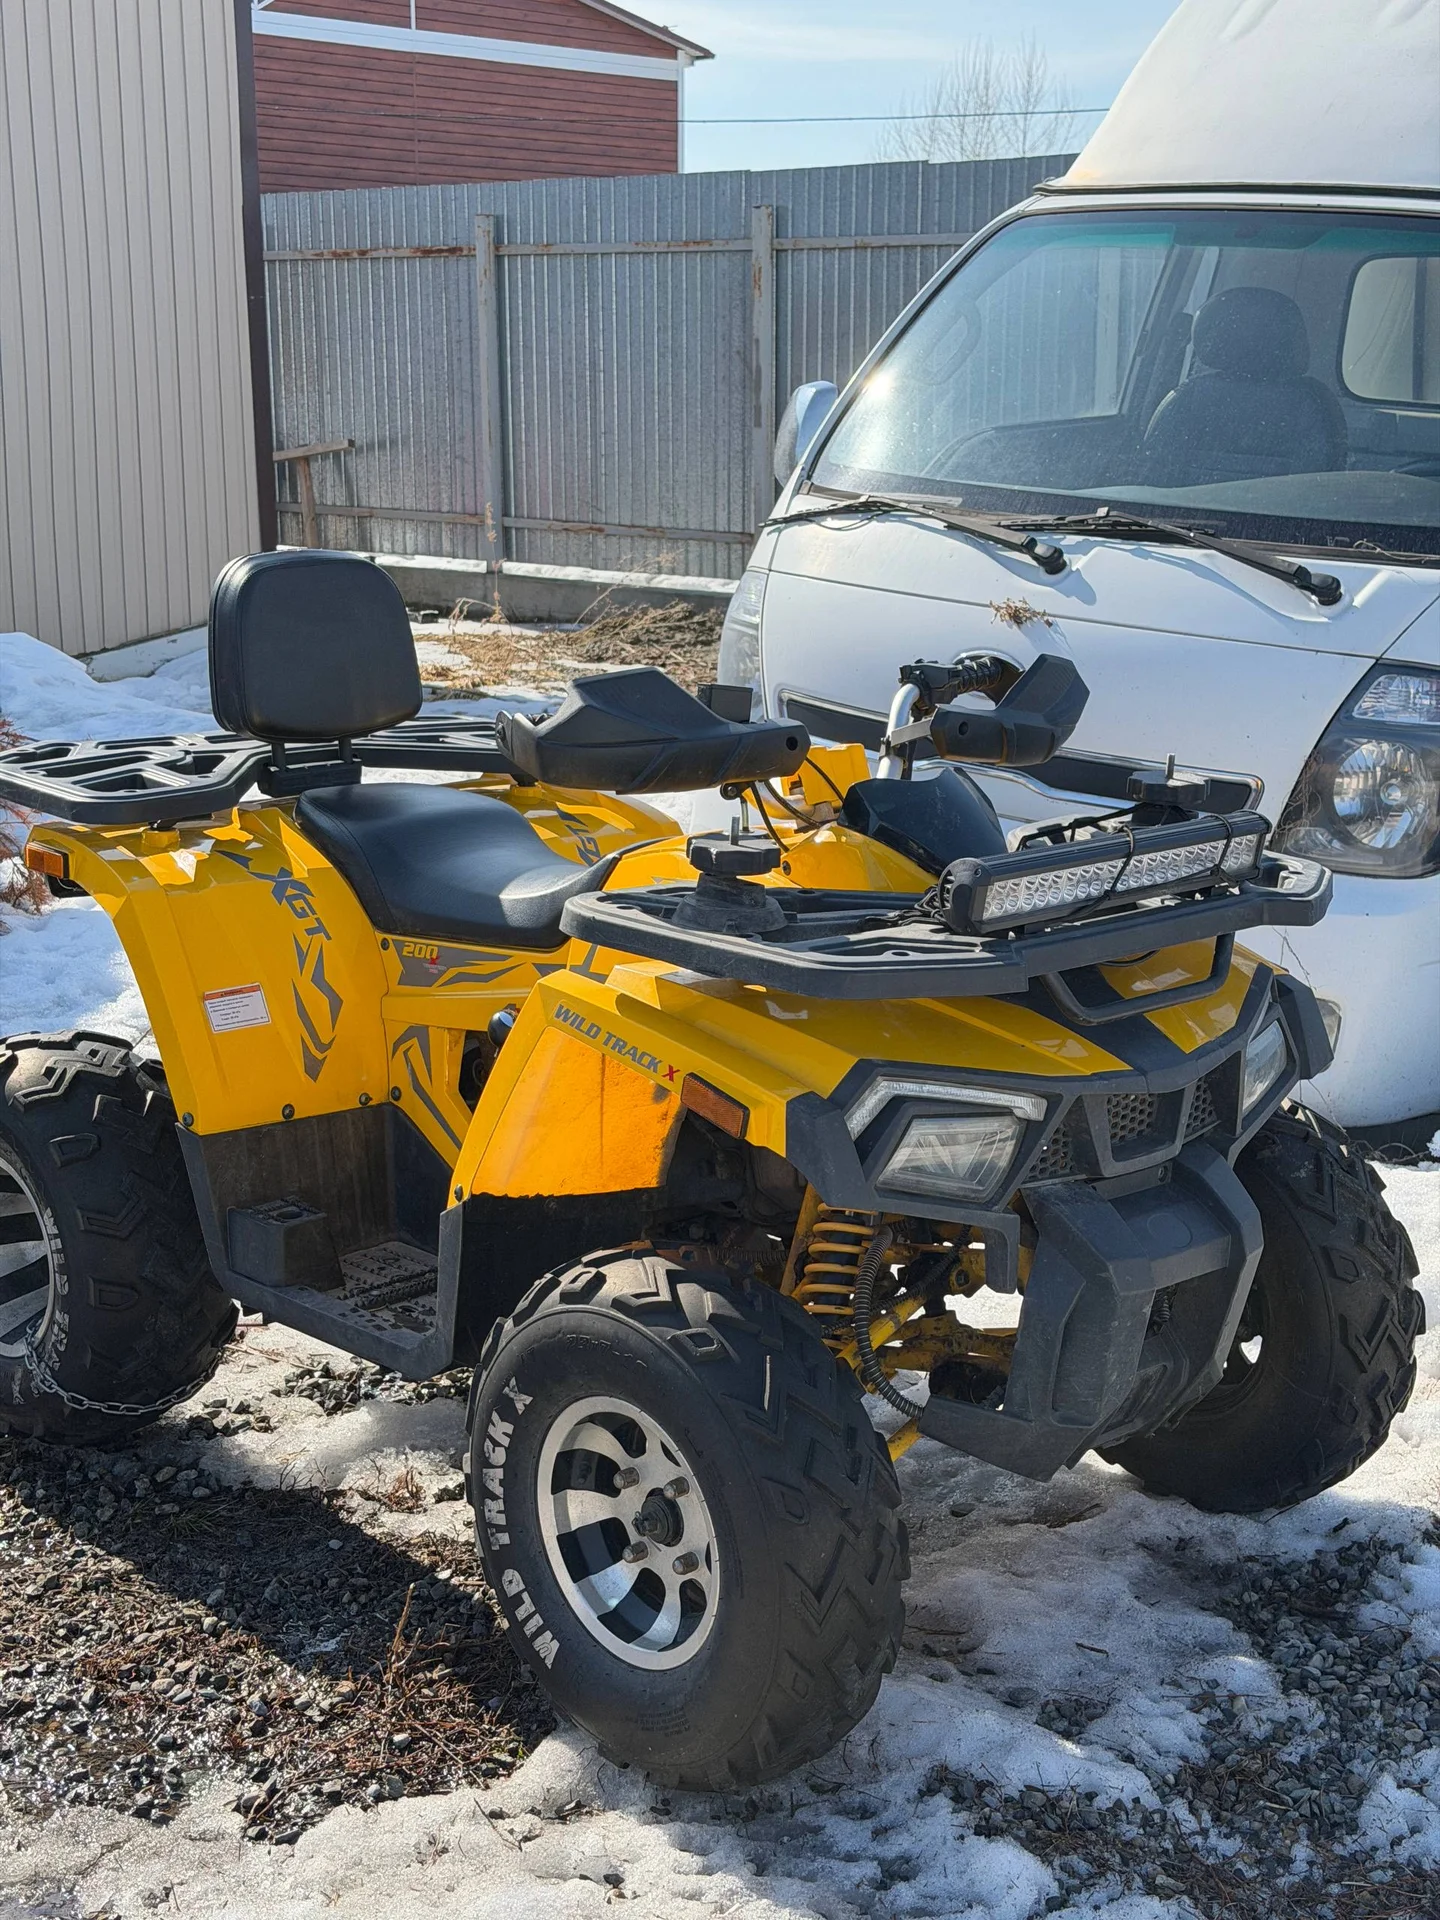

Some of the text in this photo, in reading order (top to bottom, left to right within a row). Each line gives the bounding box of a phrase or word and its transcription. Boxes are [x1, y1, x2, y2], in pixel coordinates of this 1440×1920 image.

[250, 866, 333, 941] XGT
[402, 942, 439, 960] 200
[554, 1003, 681, 1083] WILD TRACK X
[43, 1207, 69, 1296] WILD
[502, 1376, 534, 1416] X
[482, 1409, 515, 1551] TRACK
[501, 1568, 560, 1670] WILD
